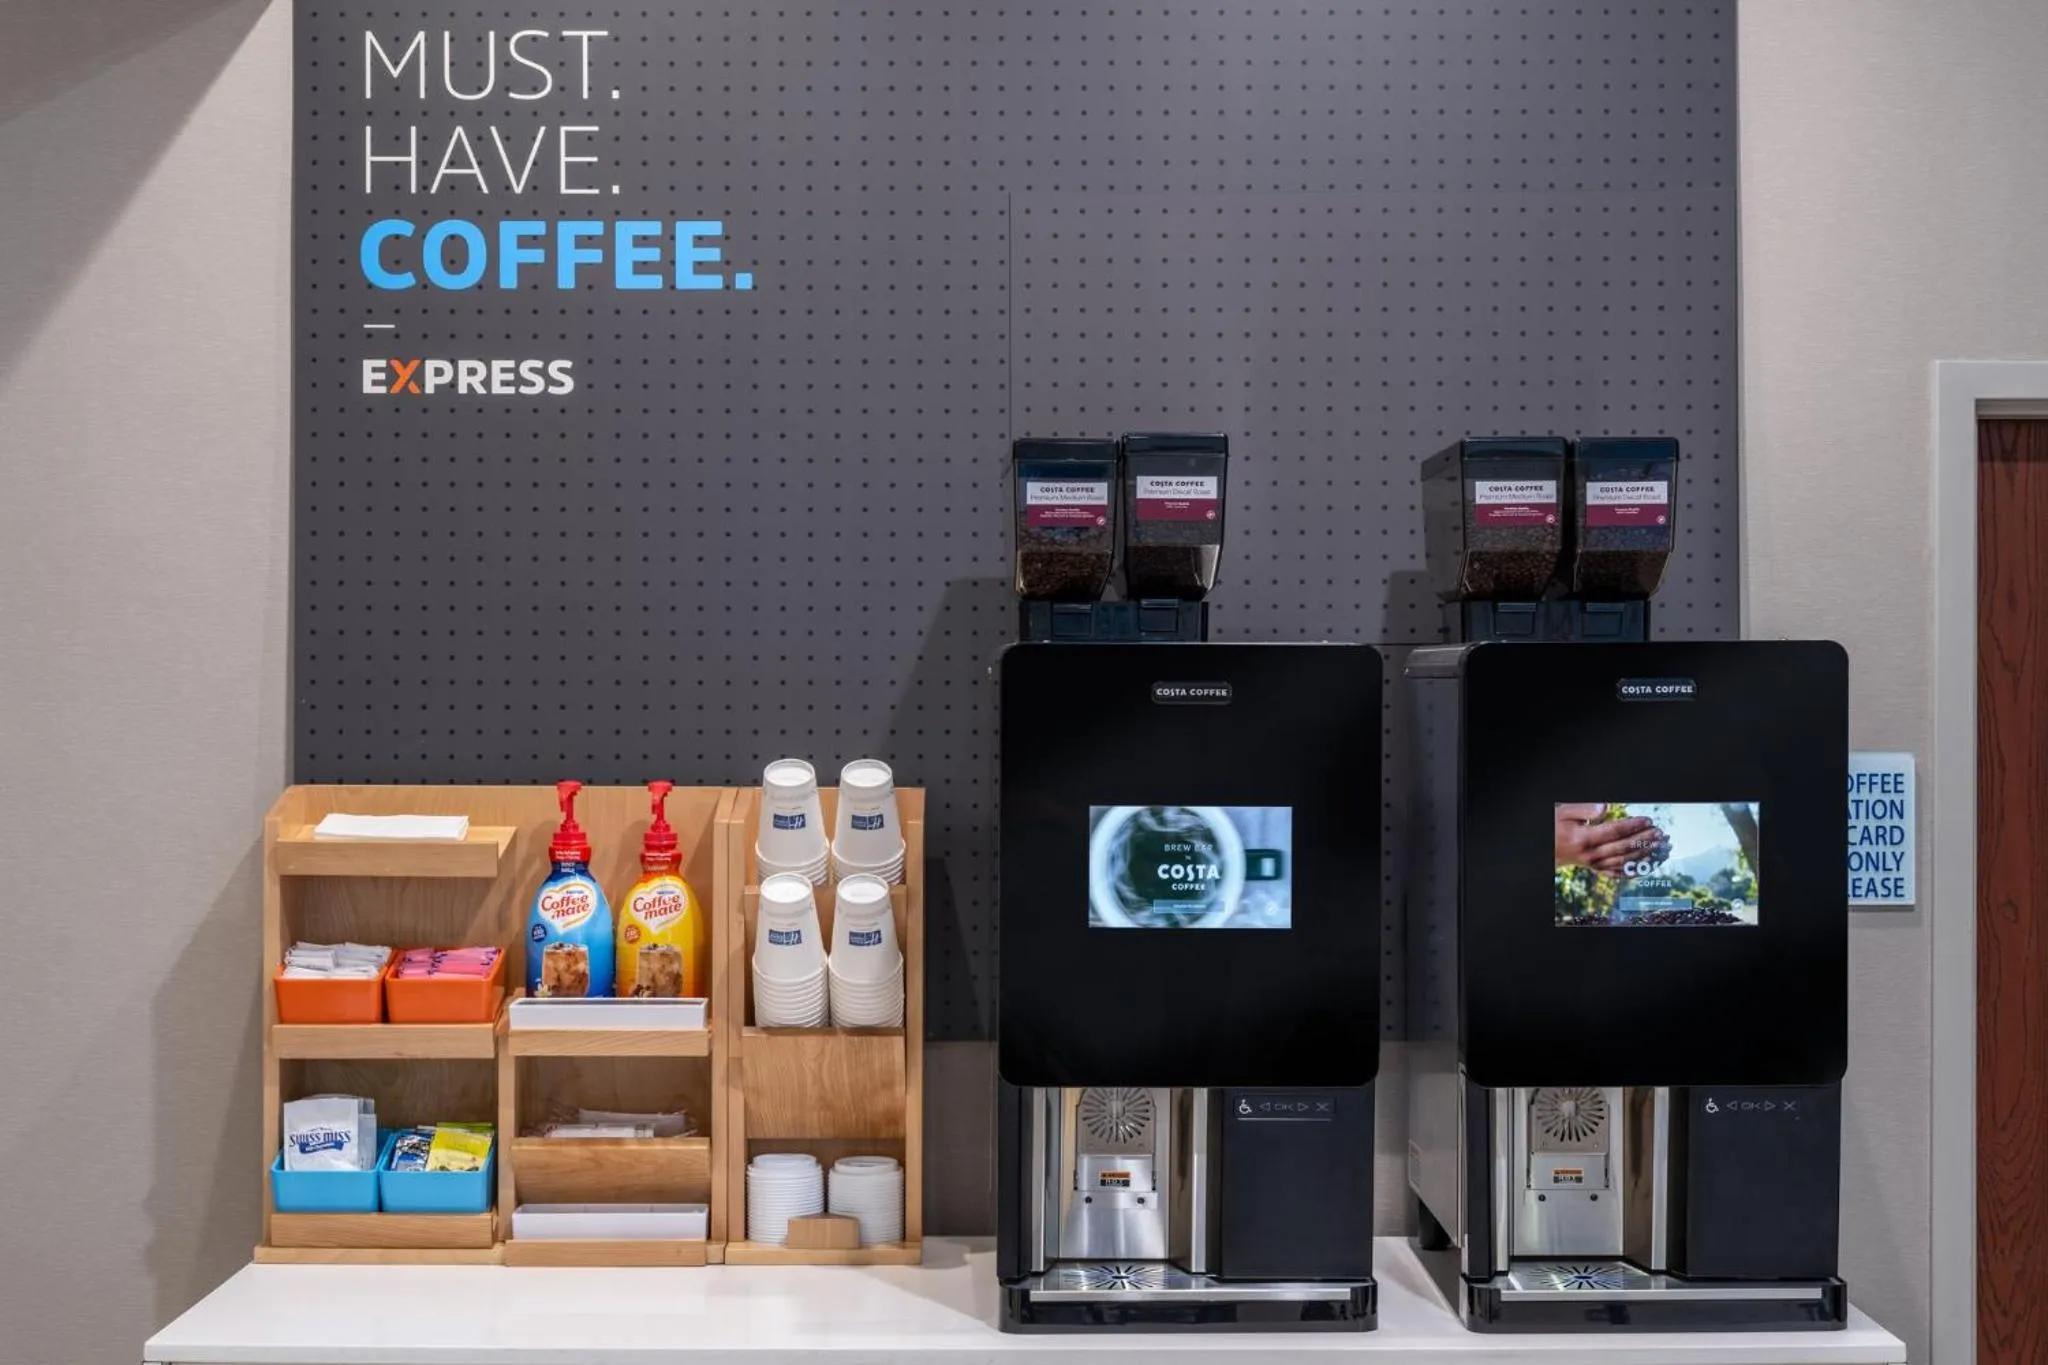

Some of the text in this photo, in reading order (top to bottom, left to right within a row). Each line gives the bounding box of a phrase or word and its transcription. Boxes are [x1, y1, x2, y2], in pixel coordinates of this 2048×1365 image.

[365, 30, 620, 100] MUST.
[365, 126, 620, 195] HAVE.
[360, 218, 754, 291] COFFEE.
[362, 359, 575, 395] EXPRESS
[1156, 688, 1228, 696] COSTA COFFEE
[1621, 685, 1693, 694] COSTA COFFEE
[1848, 799, 1904, 820] TION
[1848, 851, 1905, 872] ONLY
[1157, 864, 1220, 882] COSTA
[1171, 883, 1206, 891] COFFEE
[1848, 877, 1905, 898] EASE
[541, 893, 589, 912] Coffee
[551, 903, 590, 920] mate
[632, 893, 680, 913] Coffee
[643, 903, 682, 921] mate
